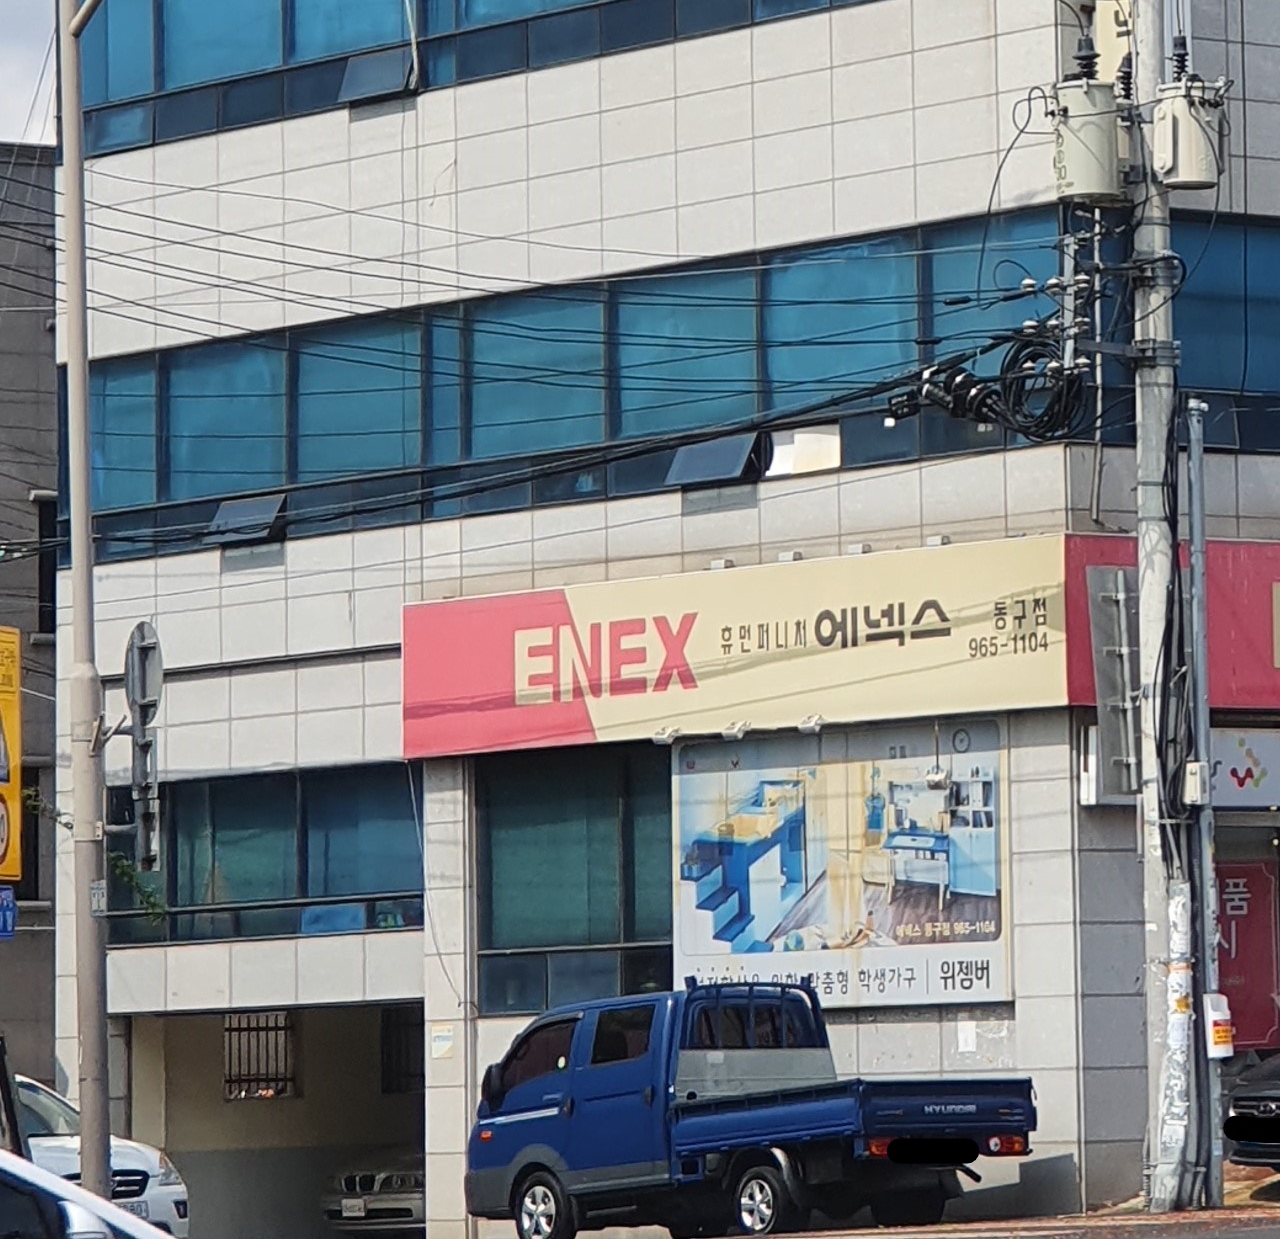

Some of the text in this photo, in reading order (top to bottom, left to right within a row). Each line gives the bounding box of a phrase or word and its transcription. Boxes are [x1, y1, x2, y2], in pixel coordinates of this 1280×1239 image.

[514, 612, 699, 706] ENEX
[814, 599, 952, 649] 에넥스
[993, 597, 1048, 631] 동구점
[967, 632, 1049, 659] 965-1104
[858, 967, 917, 994] 학생가구
[939, 959, 991, 991] 위젬버
